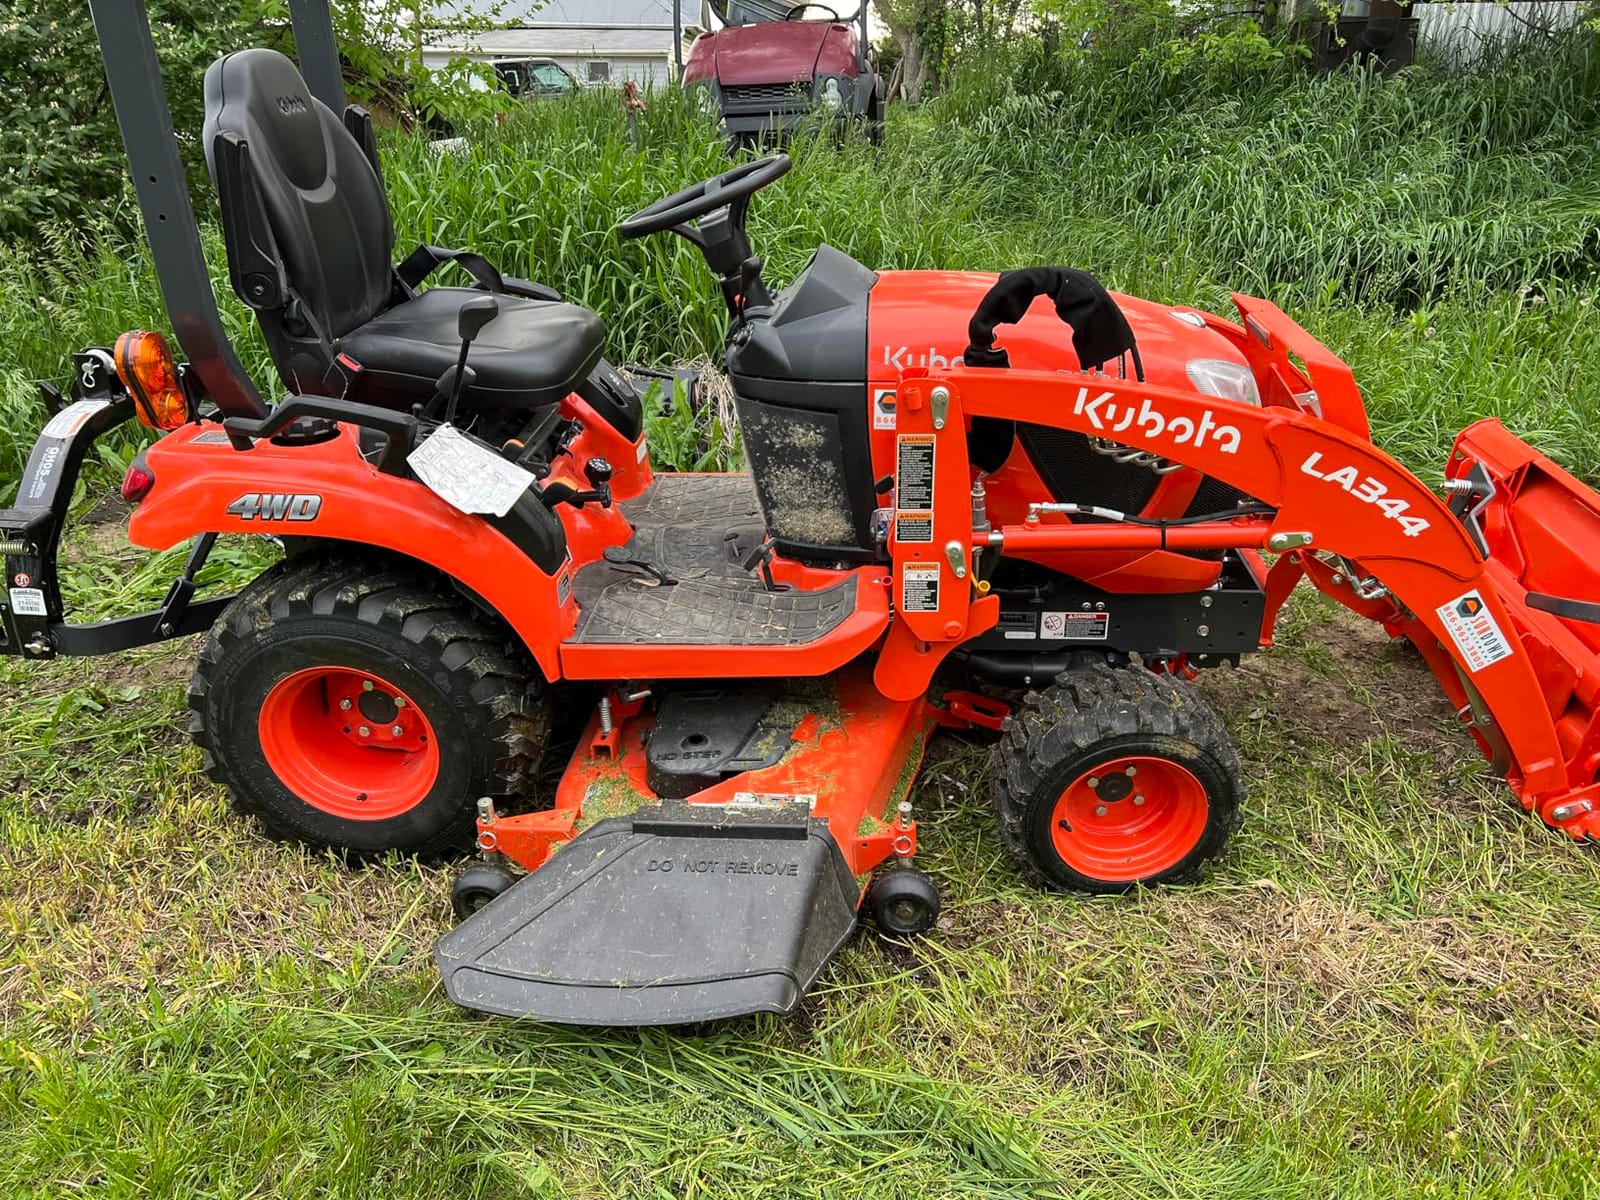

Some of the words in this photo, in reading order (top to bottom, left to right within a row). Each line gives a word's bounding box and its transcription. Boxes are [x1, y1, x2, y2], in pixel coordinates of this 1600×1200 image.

[883, 346, 965, 372] Kubo
[1073, 388, 1241, 454] Kubota
[226, 493, 323, 521] 4WD
[1301, 452, 1431, 537] LA344
[1470, 615, 1507, 660] SUNDOWN
[647, 859, 674, 873] DO
[683, 860, 720, 874] NOT
[725, 860, 799, 877] REMOVE
